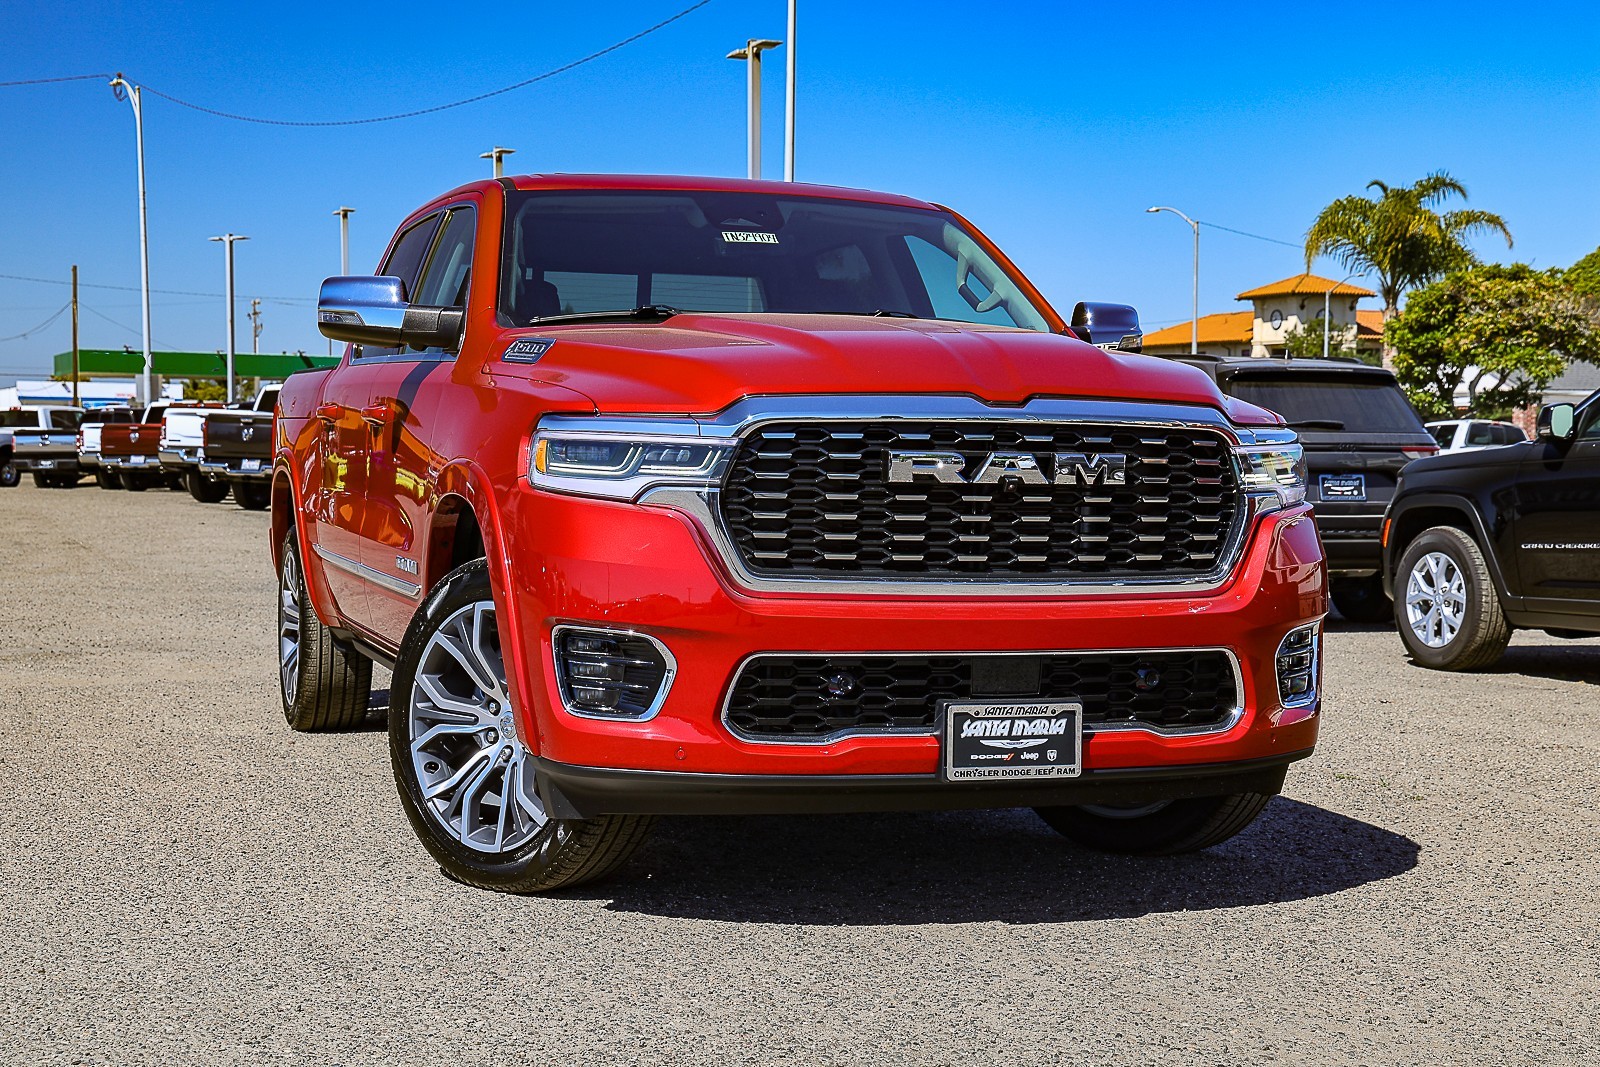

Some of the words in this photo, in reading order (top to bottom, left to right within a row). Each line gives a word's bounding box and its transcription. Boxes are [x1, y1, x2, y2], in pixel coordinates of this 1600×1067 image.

[888, 450, 1127, 485] RAM
[983, 706, 1012, 717] SANTA
[1014, 705, 1049, 716] MARIA
[960, 718, 1011, 739] SANTA
[1011, 718, 1068, 737] MARIA
[1020, 751, 1040, 761] Jeep
[953, 769, 1000, 778] CHRYSLER
[1001, 768, 1032, 777] DODGE
[1033, 767, 1054, 776] JEEP
[1056, 767, 1076, 776] RAM
